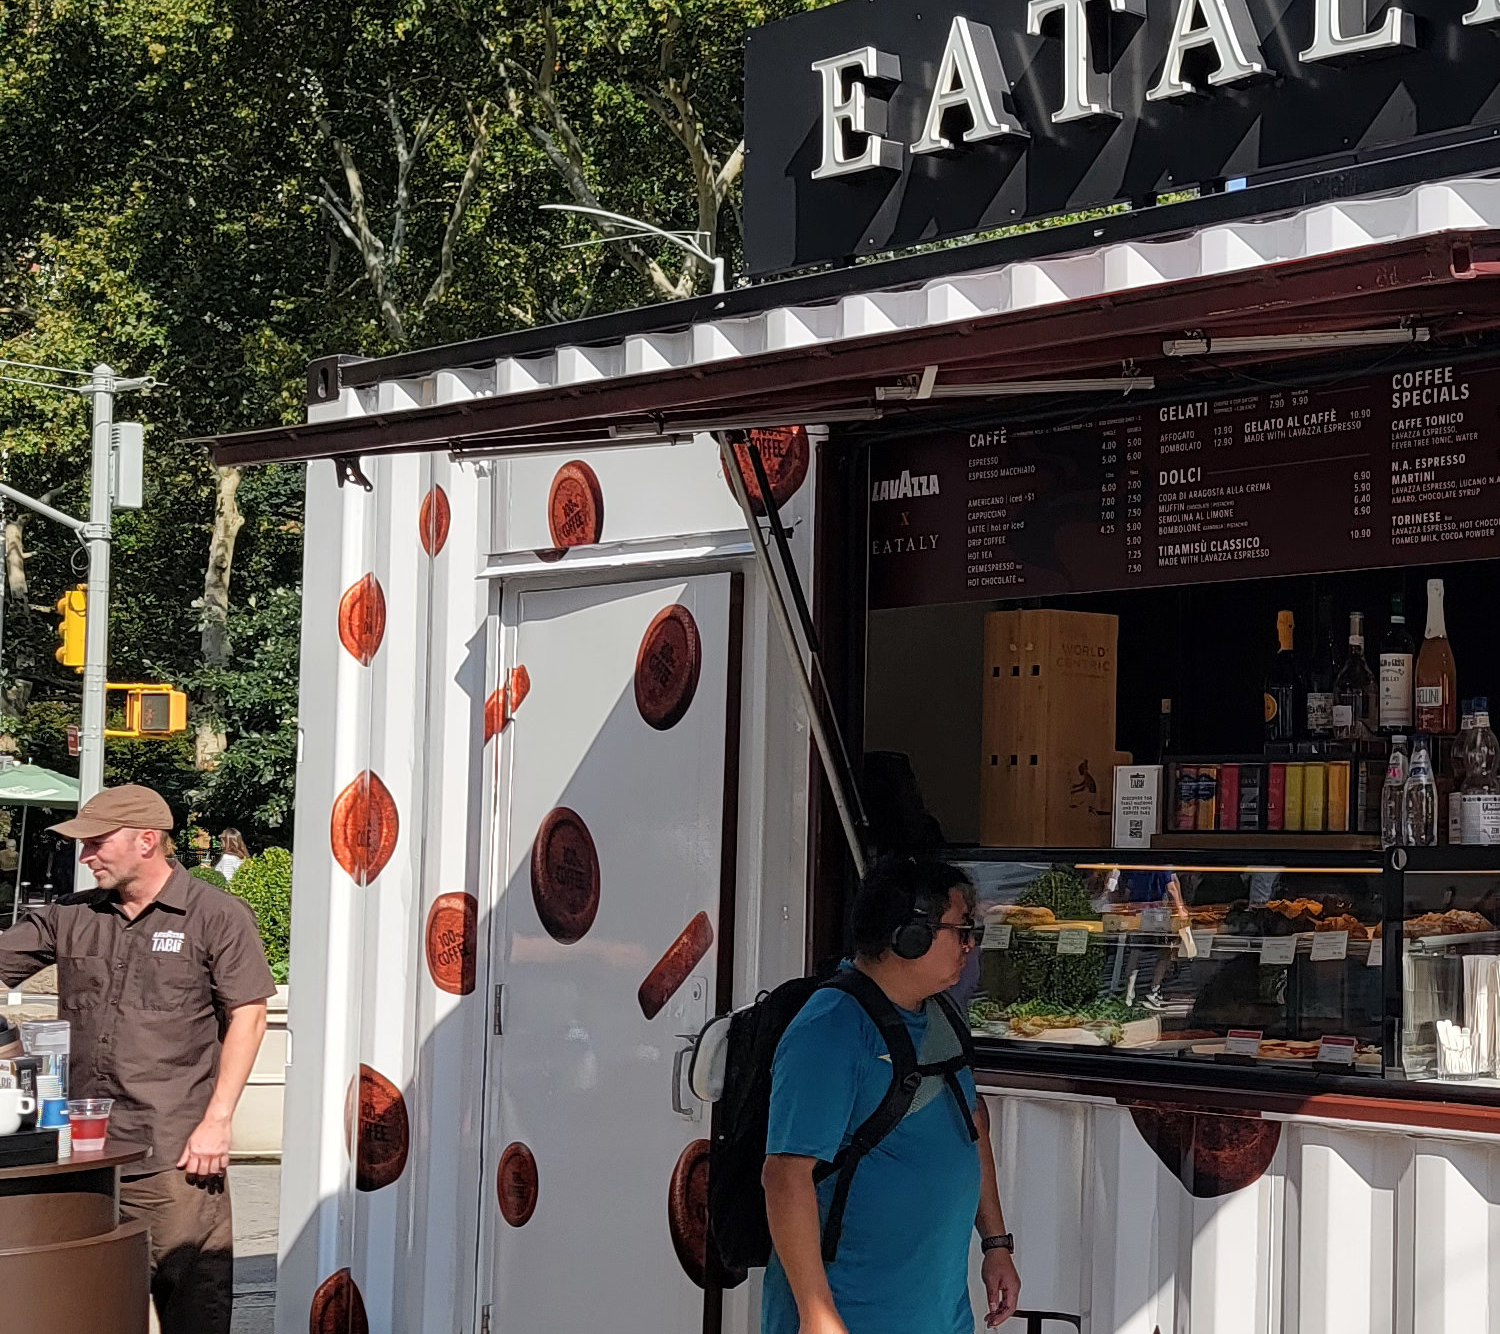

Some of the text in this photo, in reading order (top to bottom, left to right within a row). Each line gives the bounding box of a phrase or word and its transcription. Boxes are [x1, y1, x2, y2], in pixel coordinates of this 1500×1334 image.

[1392, 367, 1453, 389] COFFEE
[1292, 396, 1308, 406] 9.90
[1392, 384, 1469, 409] SPECIALS
[1160, 402, 1208, 422] GELATI
[1244, 408, 1371, 433] GELATO AL CAFFÈ 10.90
[1392, 417, 1422, 430] CAFFE
[1425, 412, 1463, 426] TONICO
[969, 427, 1007, 448] CAFFÈ
[1160, 426, 1232, 442] AFFOGATO 13.90
[1244, 421, 1361, 443] MADE WITH LAVAZZA ESPRESSO
[1392, 431, 1420, 441] LAVAZZA
[1214, 438, 1232, 447] 12.90
[1392, 432, 1478, 450] FEVER TREE WATER
[969, 456, 999, 467] ESPRESSO
[1416, 454, 1466, 469] ESPRESSO
[968, 465, 1035, 480] ESPRESSO MACCHIATO
[1160, 467, 1201, 486] DOLCI
[1392, 471, 1435, 485] MARTINI
[872, 470, 940, 501] LAVAZZA
[1159, 482, 1271, 503] CODA DI ARAGOSTA ALLA CREMA
[1392, 477, 1487, 495] LAVAZZA LUCANO
[968, 496, 1003, 507] AMERICANO
[1159, 483, 1371, 513] MUFFIN 5.90
[1419, 488, 1480, 502] CHOCOLATE SYRUP
[968, 509, 1006, 520] CAPPUCCINO
[1159, 509, 1234, 524] SEMOLINA AL LIMONE
[1392, 512, 1441, 526] TORINESE
[1159, 524, 1201, 535] BOMBOLONE
[1392, 527, 1421, 535] LAVAZZA
[1392, 529, 1495, 545] FOAMED COCOA POWDER
[872, 534, 940, 555] EATALY
[983, 536, 1006, 546] COFFEE
[1158, 529, 1371, 557] TIRAMISÙ CLASSICO 10.90
[1159, 549, 1269, 567] MADE WITH LAVAZZA ESPRESSO
[968, 562, 1014, 573] CREMESPRESSO
[981, 576, 1016, 586] CHOCOLATE
[1062, 644, 1106, 658] WORLD
